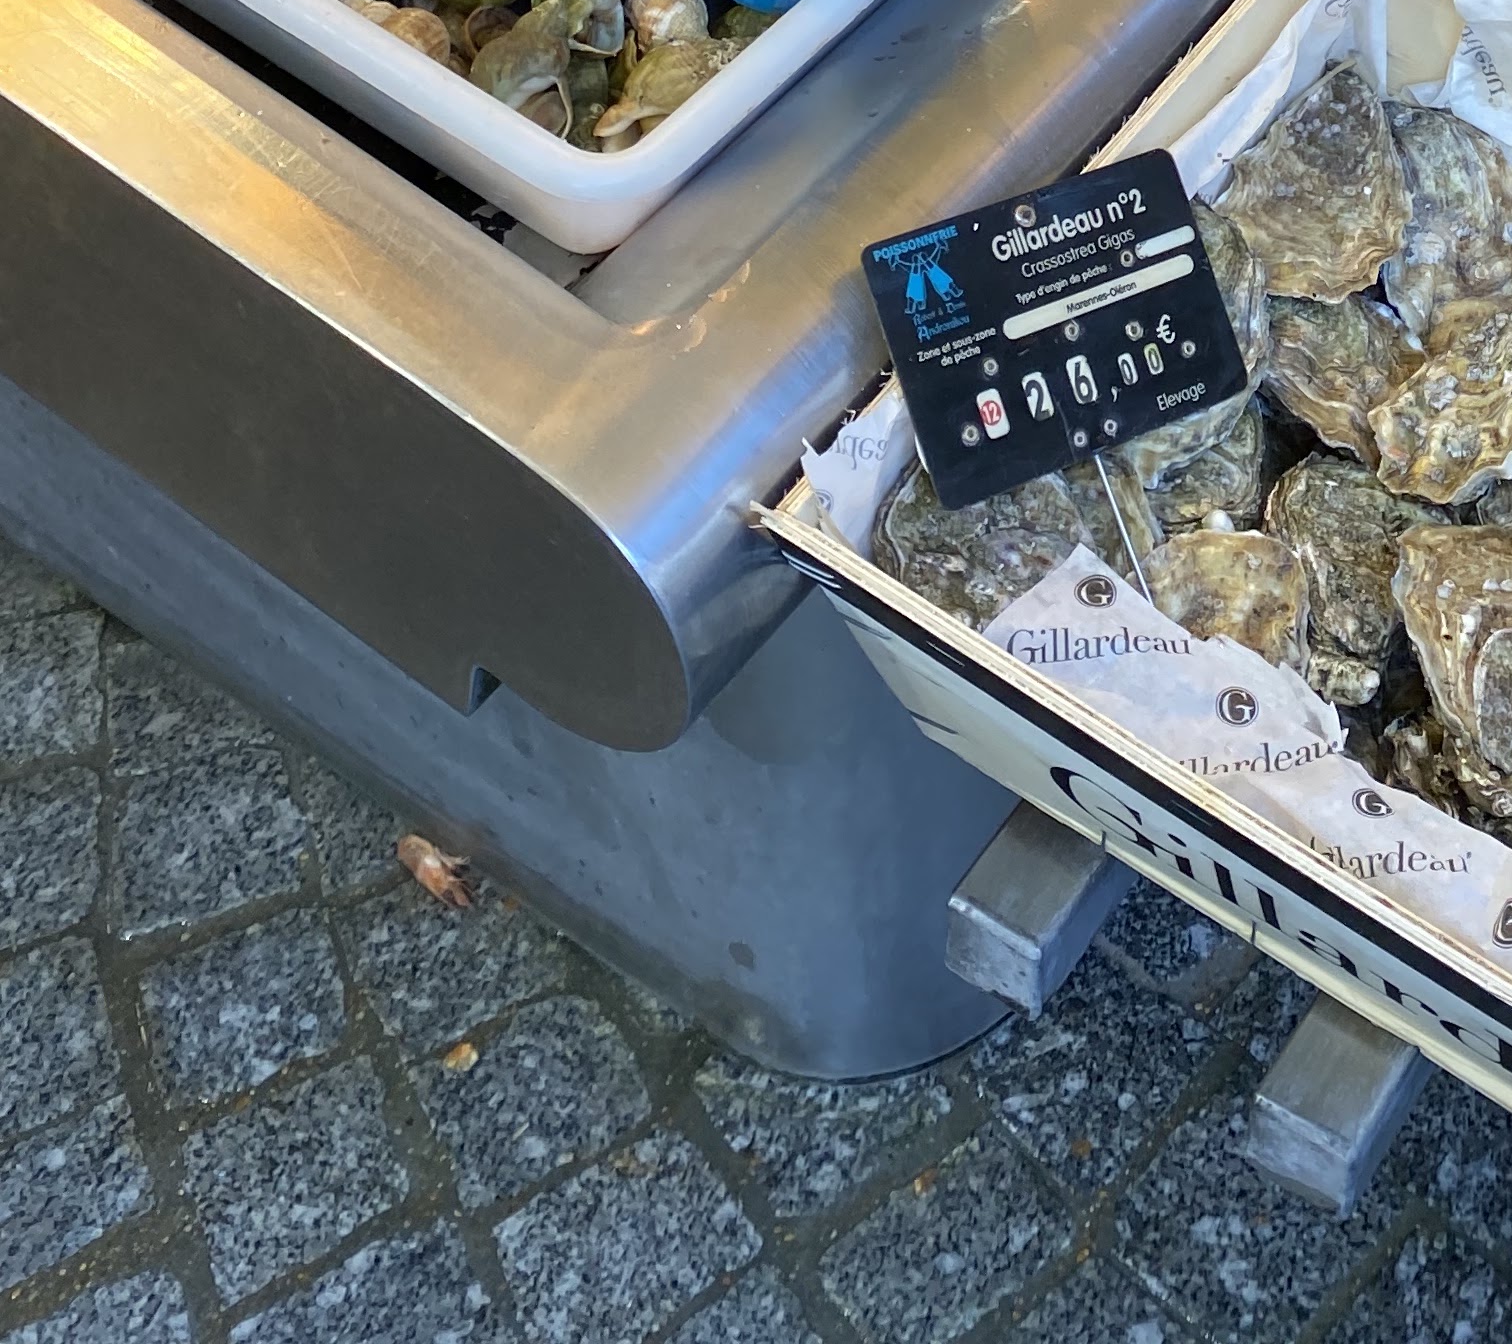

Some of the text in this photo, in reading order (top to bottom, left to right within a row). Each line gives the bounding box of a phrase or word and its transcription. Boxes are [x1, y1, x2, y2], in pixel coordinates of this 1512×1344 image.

[988, 187, 1148, 263] Gillardeau n°2
[872, 225, 958, 262] POISSONNERIE
[1020, 227, 1137, 279] Crassostrea Gigas
[1015, 289, 1038, 304] Type
[1080, 263, 1109, 281] pêche
[1064, 280, 1138, 313] Marennes-Oléron
[916, 345, 942, 361] Zone
[950, 326, 998, 349] sous-zone
[939, 344, 982, 366] de pêche
[980, 399, 1003, 426] 12
[1155, 380, 1208, 411] Elevage
[1007, 626, 1191, 664] Gillardeau
